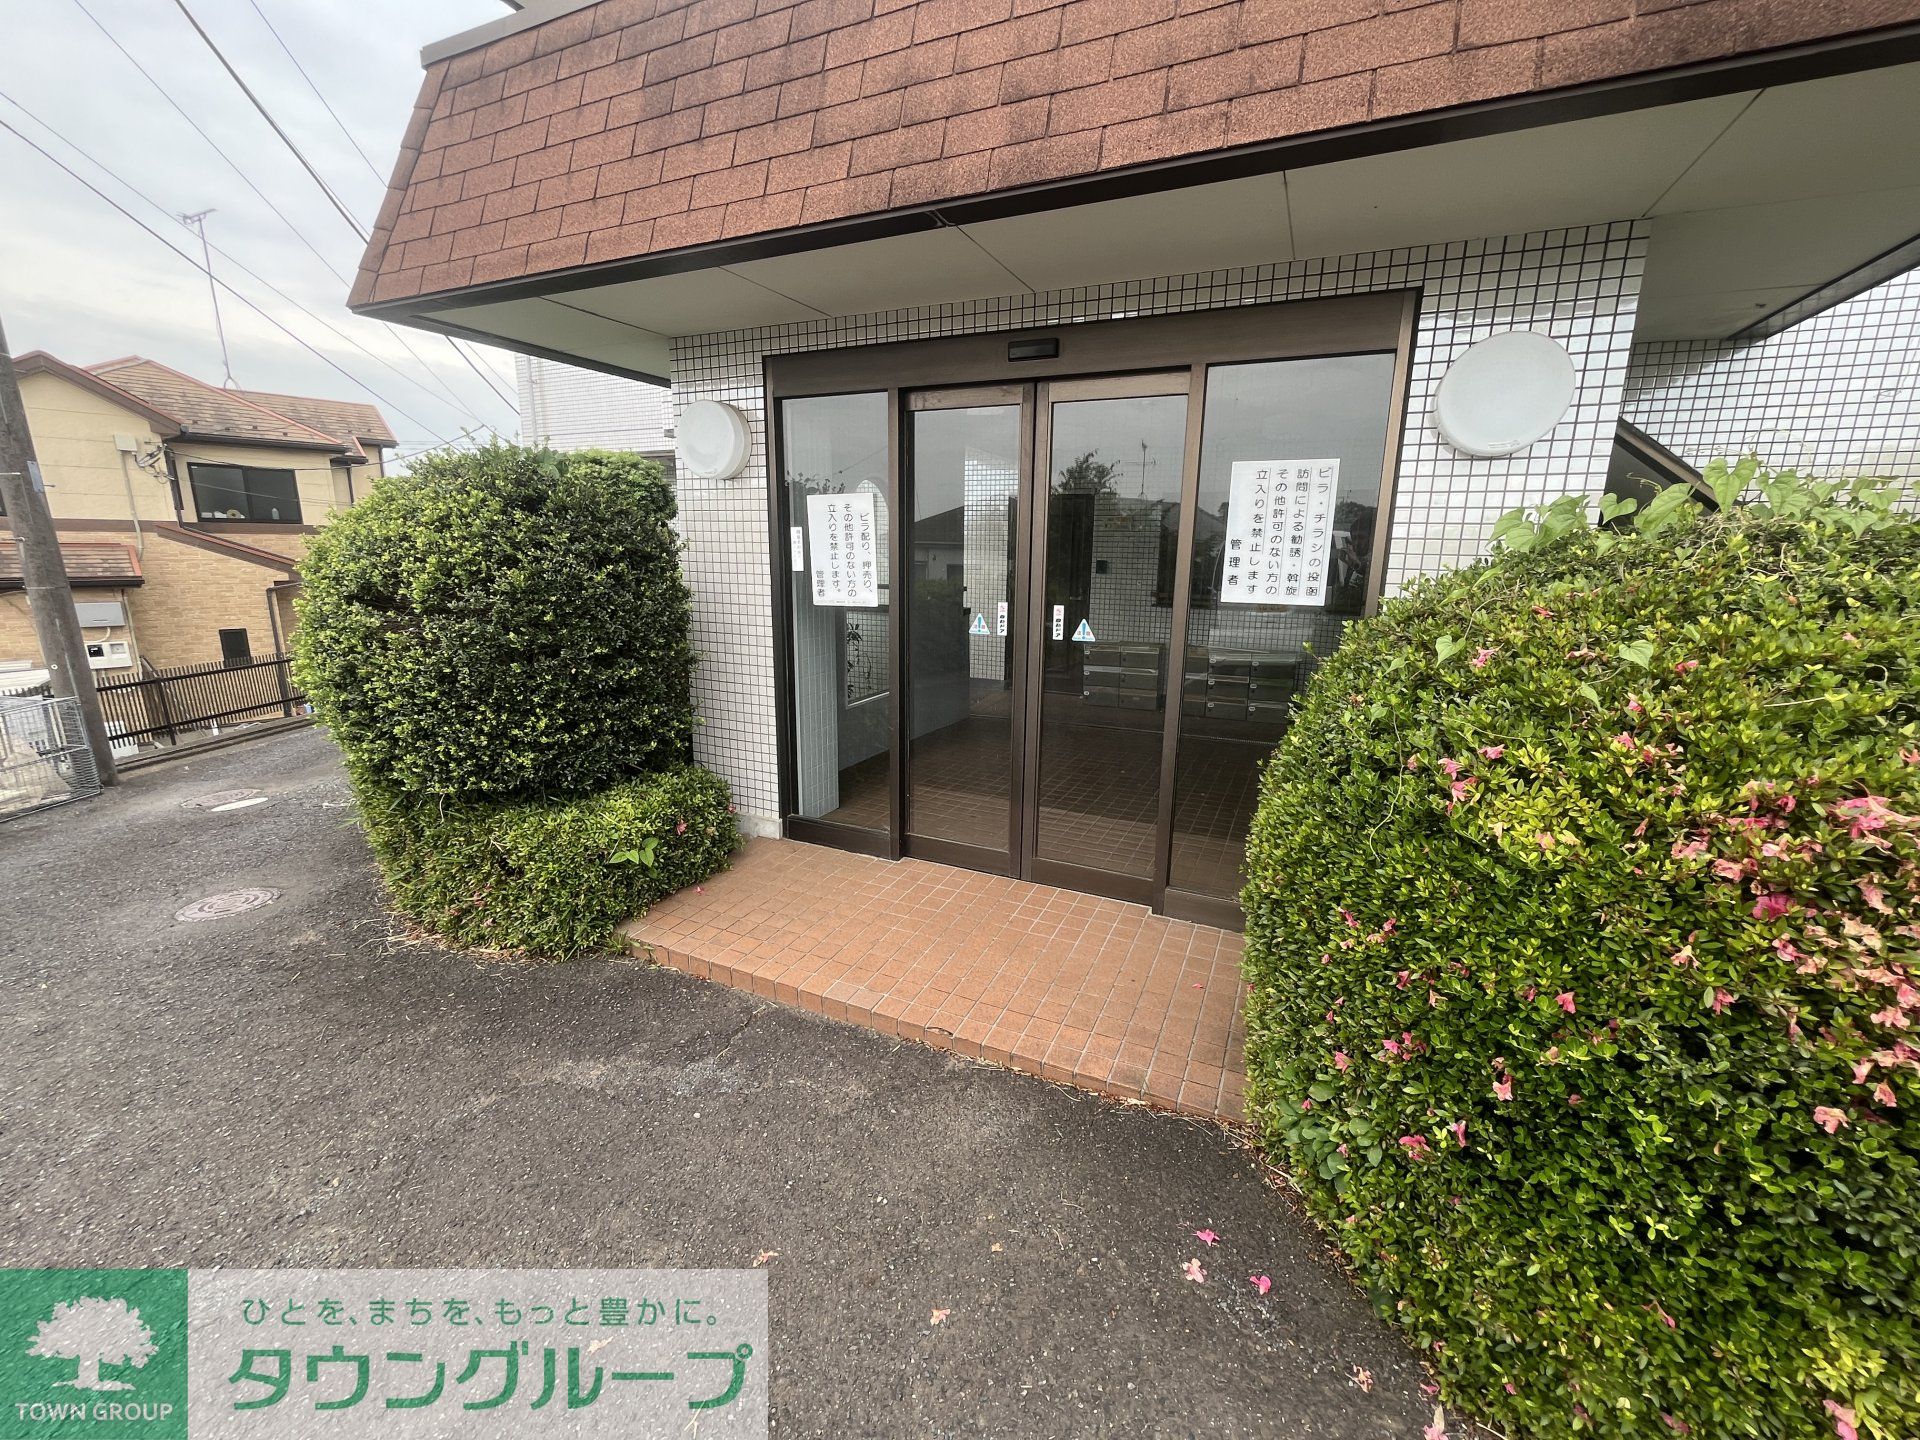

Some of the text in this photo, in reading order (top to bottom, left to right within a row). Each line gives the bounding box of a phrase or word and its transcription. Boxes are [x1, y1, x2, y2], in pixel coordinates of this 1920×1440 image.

[815, 570, 825, 597] 管理者
[827, 504, 841, 593] 立入りを禁止します。
[843, 503, 857, 597] その他許可のない方の
[1227, 538, 1242, 586] 管理者
[1246, 469, 1268, 594] 立入りを禁止します
[1265, 468, 1289, 595] その他許可のない方の
[1285, 468, 1309, 596] 訪問による勧誘・斡旋
[1305, 467, 1332, 597] ビラ・チラシの投函
